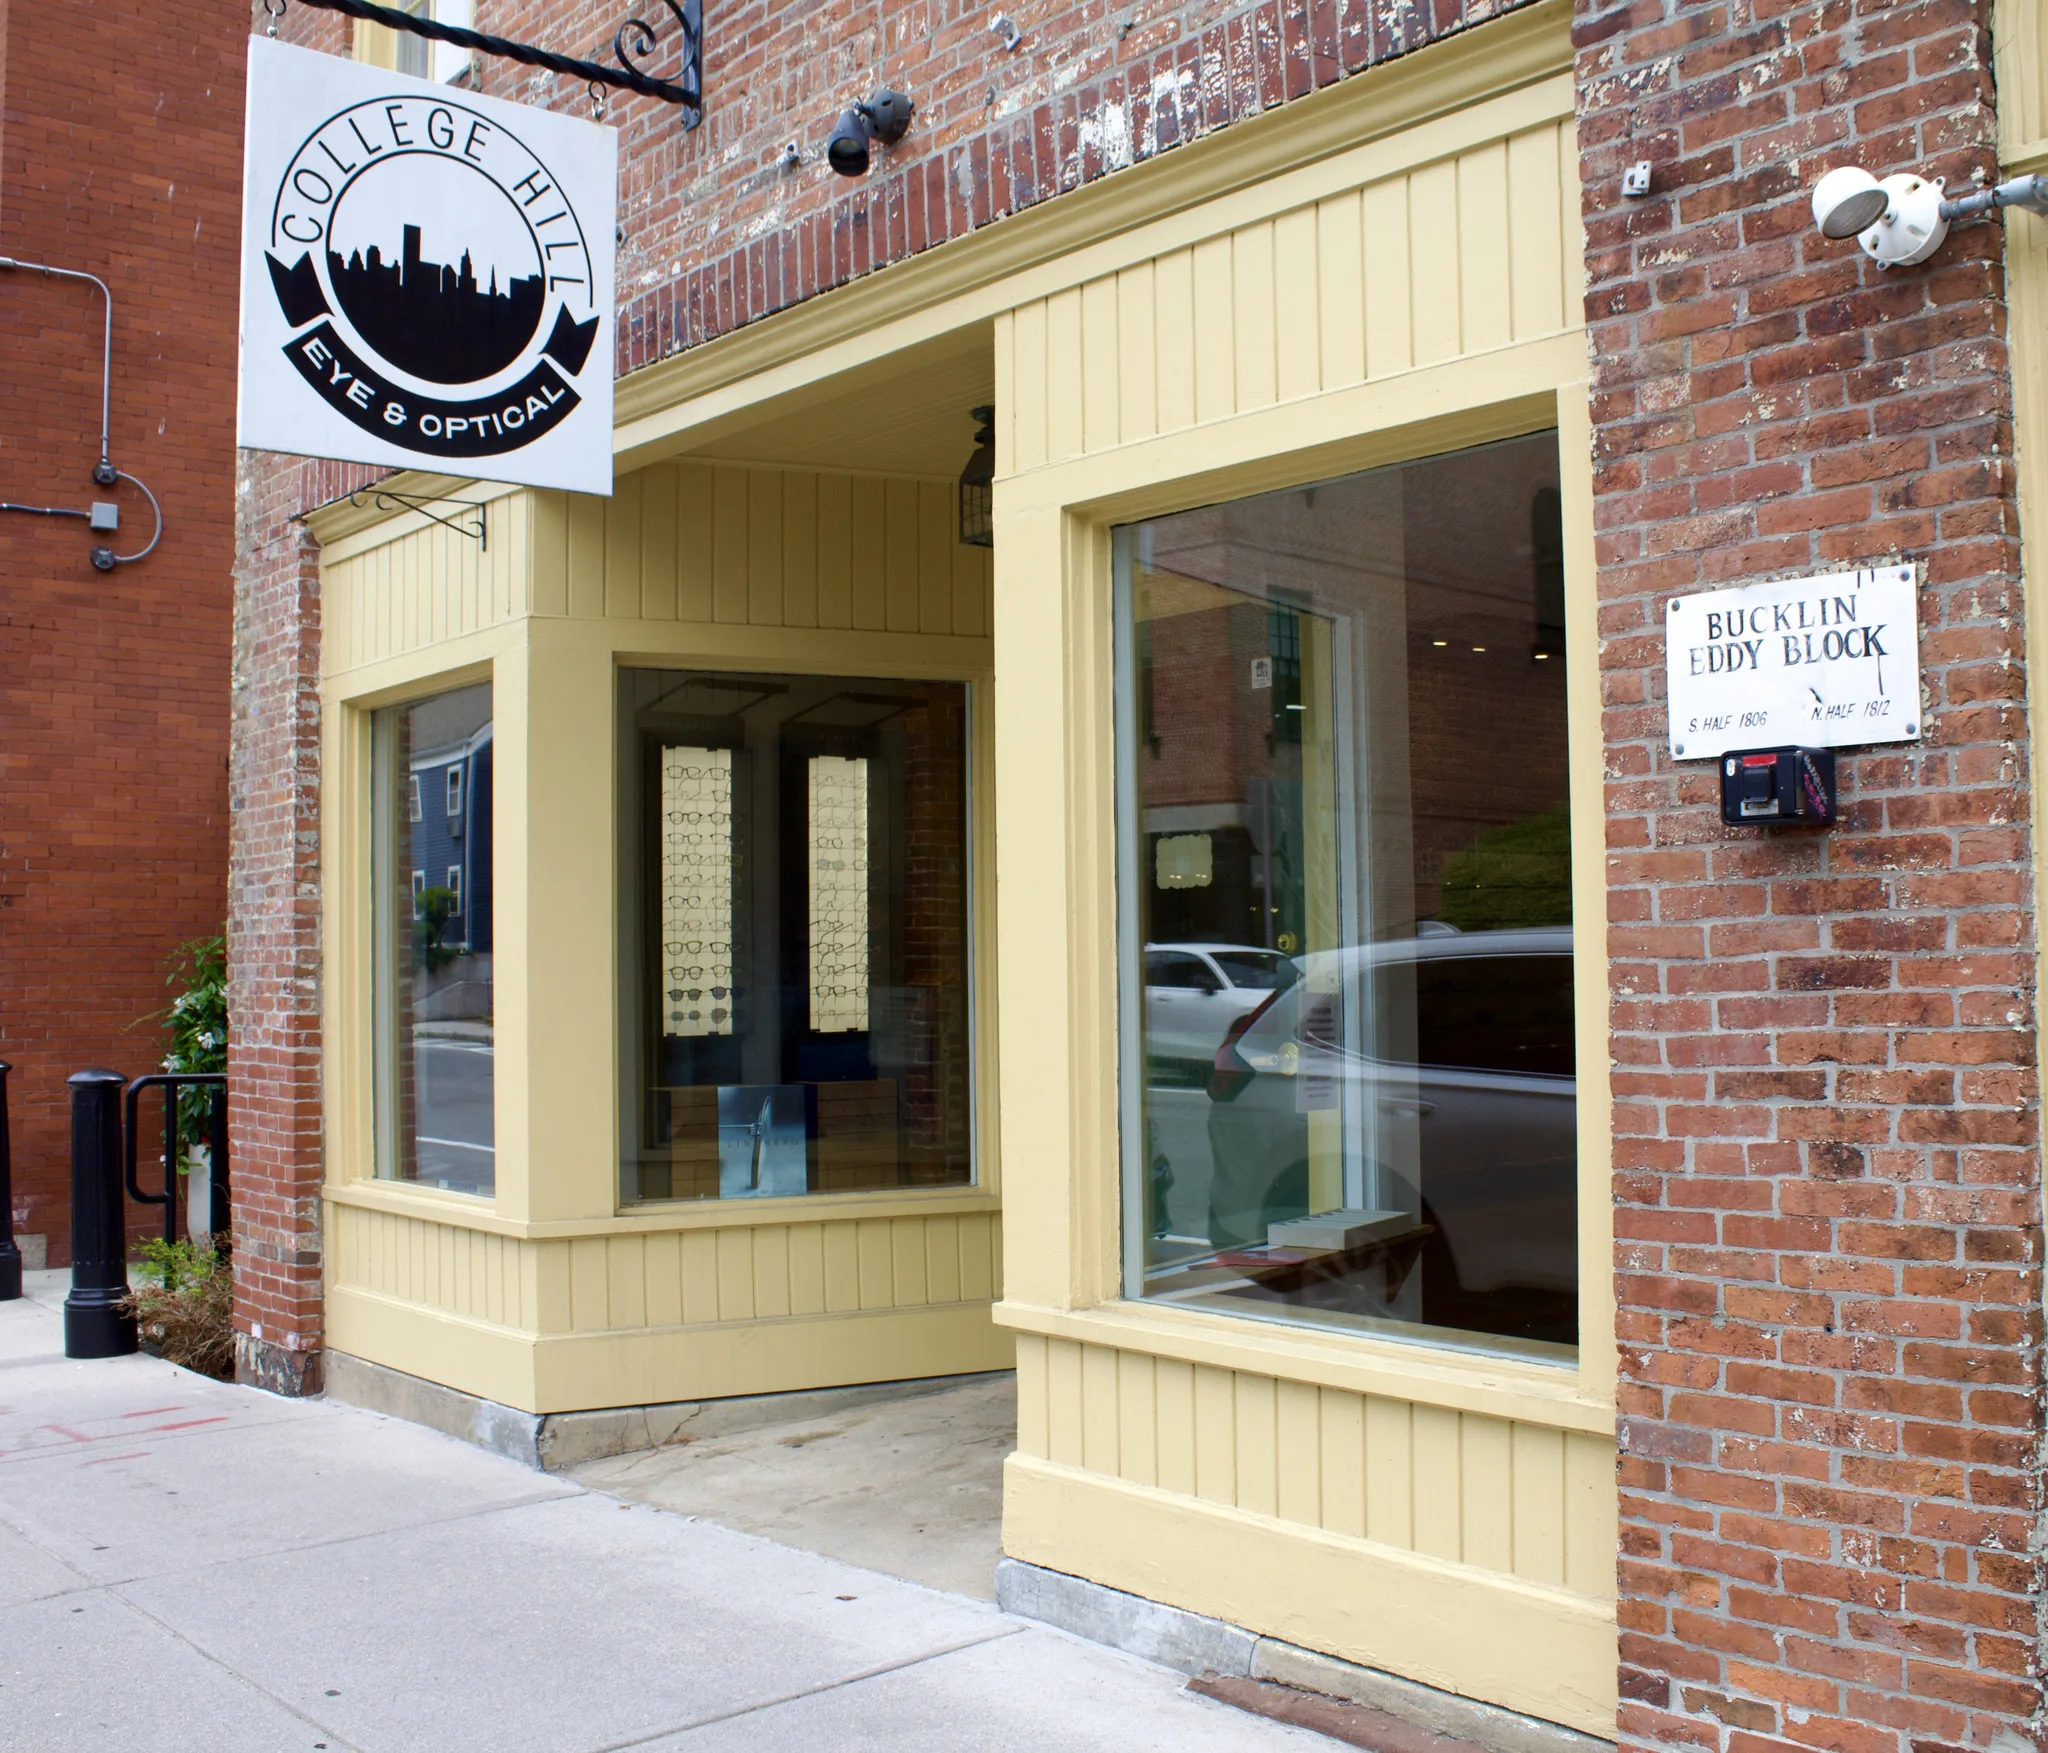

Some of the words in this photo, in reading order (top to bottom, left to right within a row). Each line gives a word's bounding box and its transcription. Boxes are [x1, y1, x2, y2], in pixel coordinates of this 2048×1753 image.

[282, 105, 490, 243] COLLEGE
[513, 169, 584, 292] HILL
[302, 338, 375, 410] EYE
[384, 403, 407, 426] &
[419, 384, 565, 439] OPTICAL
[1706, 595, 1857, 640] BUCKLIN
[1689, 639, 1764, 677] EDDY
[1783, 624, 1890, 667] BLOCK
[1703, 715, 1732, 731] HALF
[1739, 711, 1768, 728] 1806
[1826, 702, 1855, 719] HALF
[1864, 700, 1890, 716] 1812
[728, 1138, 799, 1148] LINBERG
